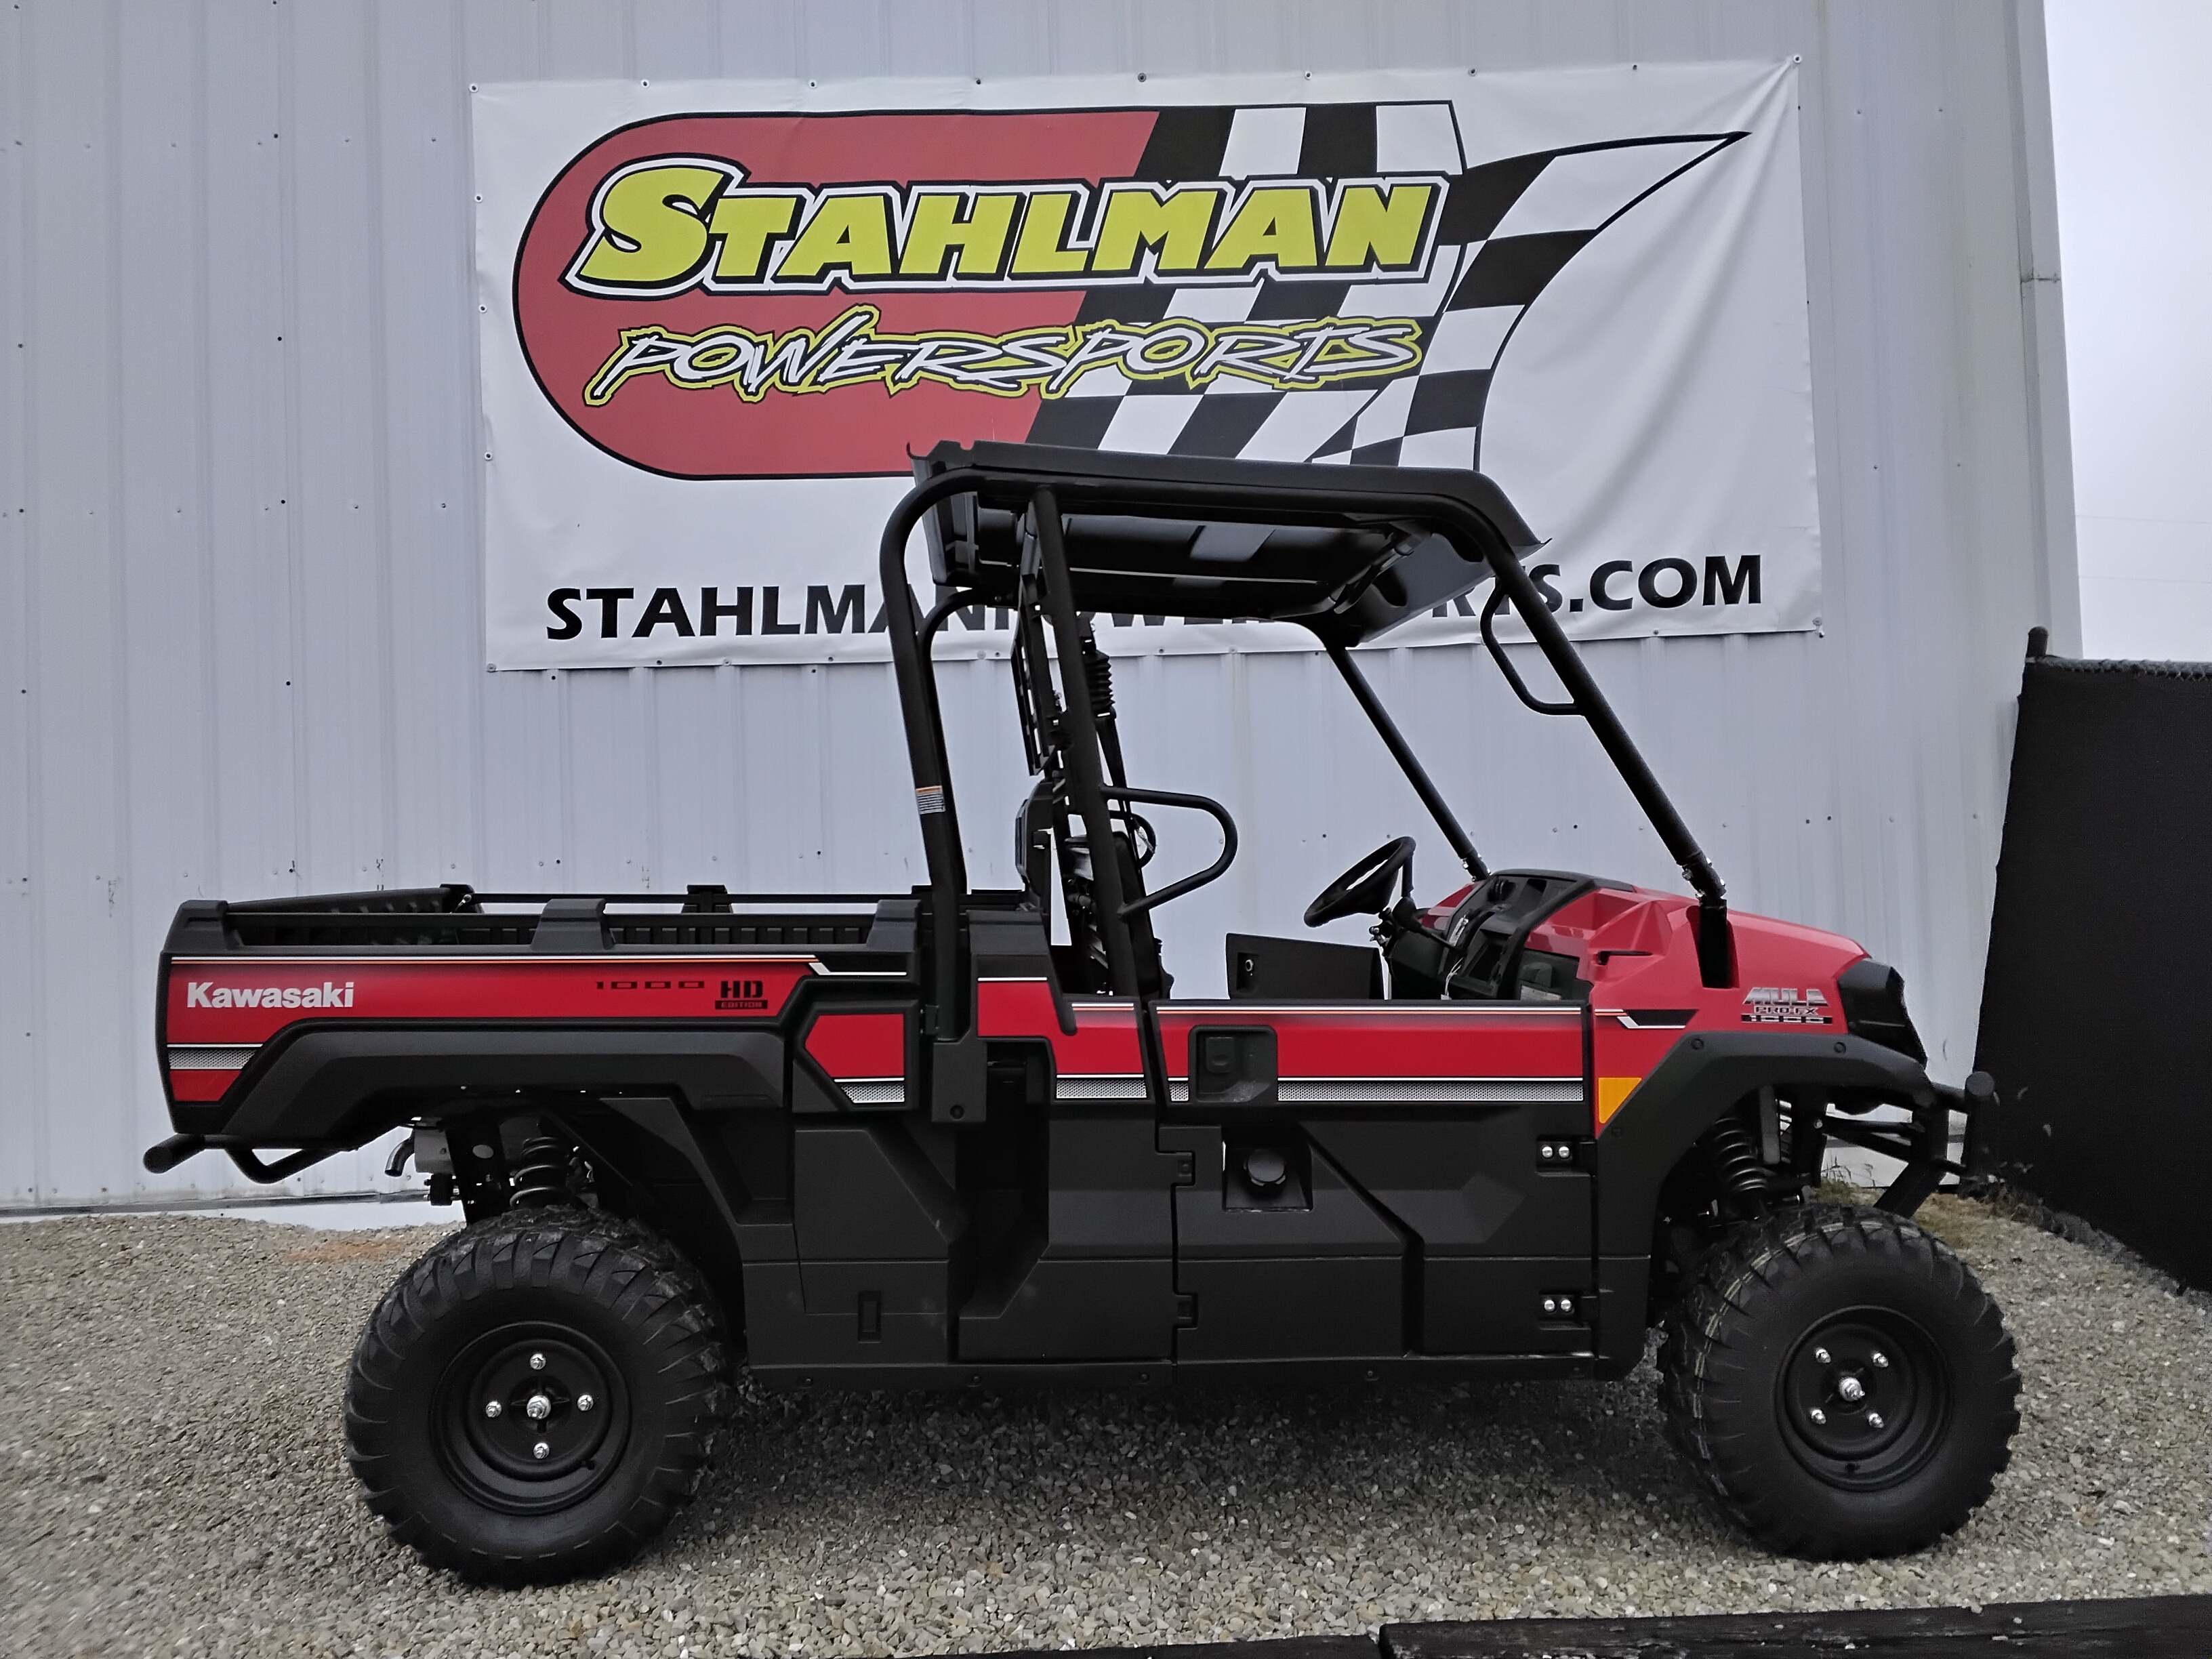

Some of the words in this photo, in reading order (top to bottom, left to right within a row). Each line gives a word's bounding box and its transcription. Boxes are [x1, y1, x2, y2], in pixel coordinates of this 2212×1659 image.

[561, 155, 1449, 300] STAHLMAN
[584, 305, 1423, 406] POWERSPORTS
[187, 982, 354, 1008] Kawasaki
[596, 981, 705, 989] 1000
[720, 980, 763, 998] HD
[719, 1000, 764, 1009] EDITION
[1749, 1015, 1824, 1024] 1000
